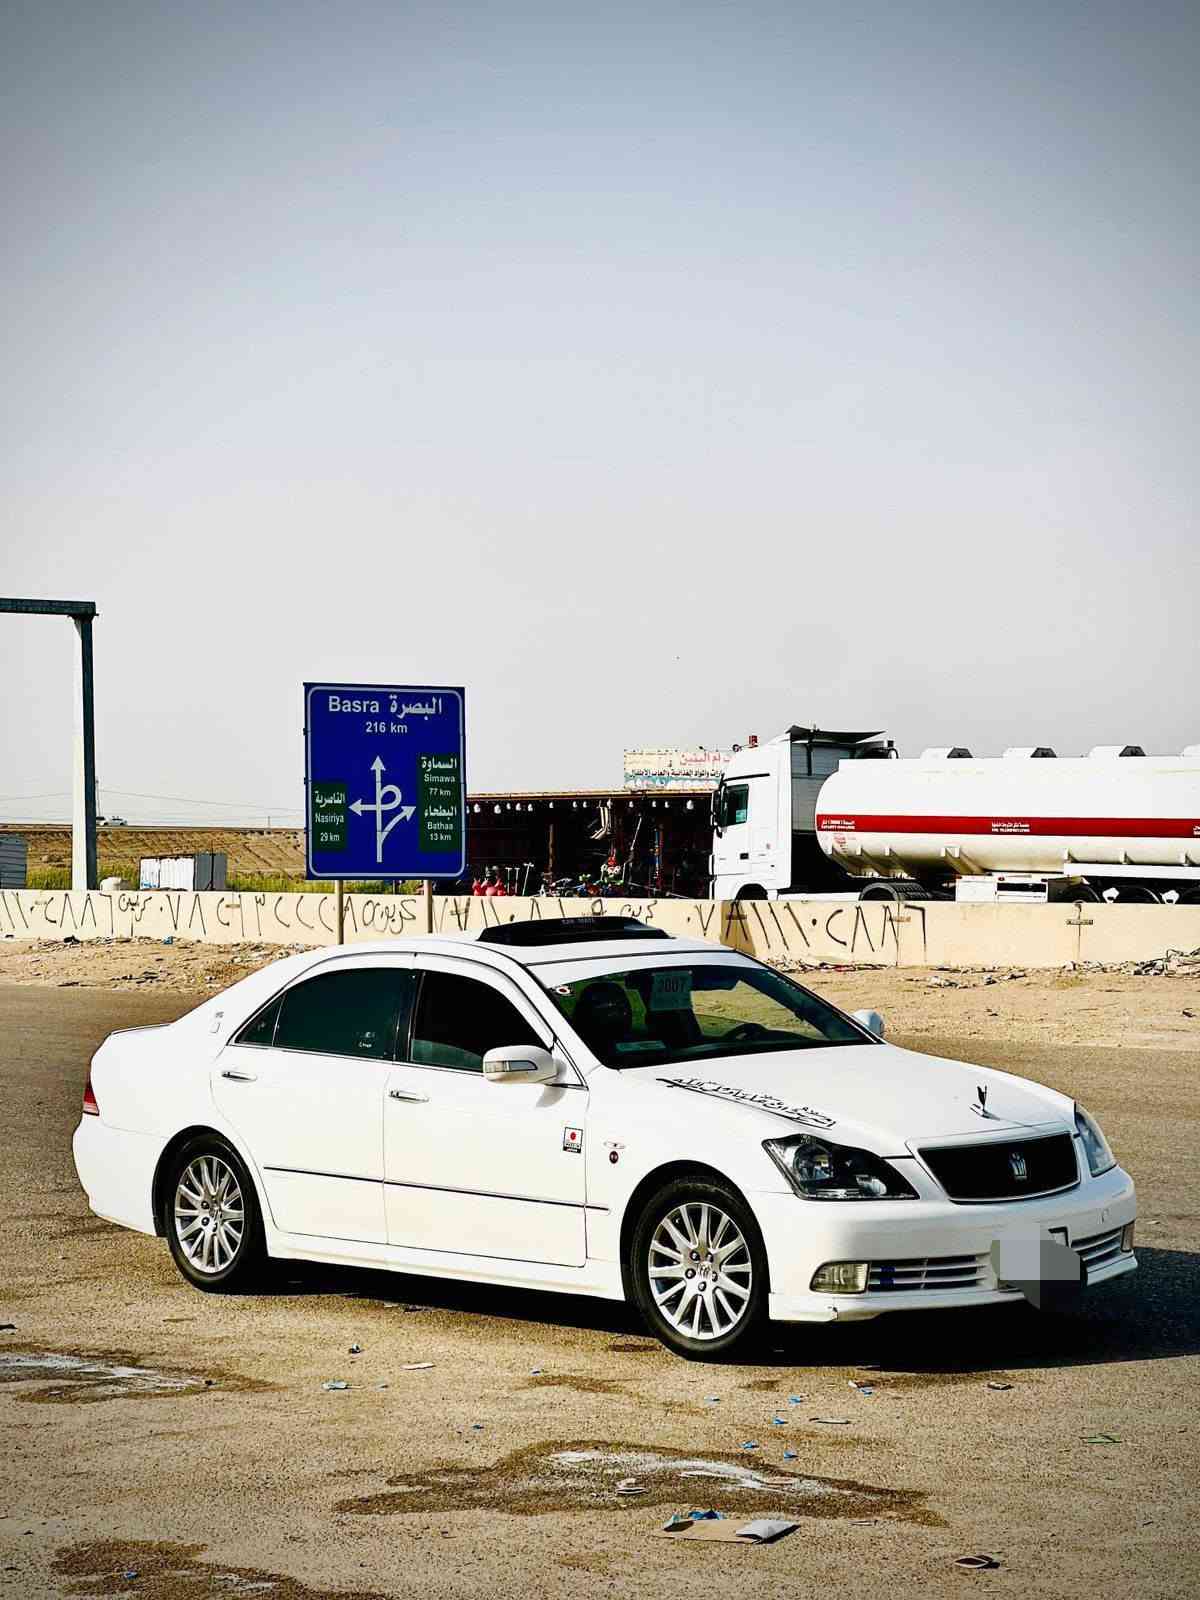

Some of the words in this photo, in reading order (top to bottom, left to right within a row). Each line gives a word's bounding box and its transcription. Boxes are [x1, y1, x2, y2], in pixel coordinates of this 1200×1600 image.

[328, 695, 379, 713] Basra
[389, 694, 442, 720] البصرة
[365, 721, 386, 733] 216
[390, 721, 408, 733] km
[421, 756, 457, 772] السماوة
[424, 774, 455, 783] Simawa
[429, 787, 438, 796] 77
[440, 787, 451, 796] km
[314, 790, 346, 808] الناصرية
[315, 812, 345, 825] Nasiriya
[424, 804, 457, 821] البطحاء
[320, 832, 328, 842] 29
[330, 832, 340, 842] km
[430, 832, 438, 841] 13
[440, 832, 452, 841] km
